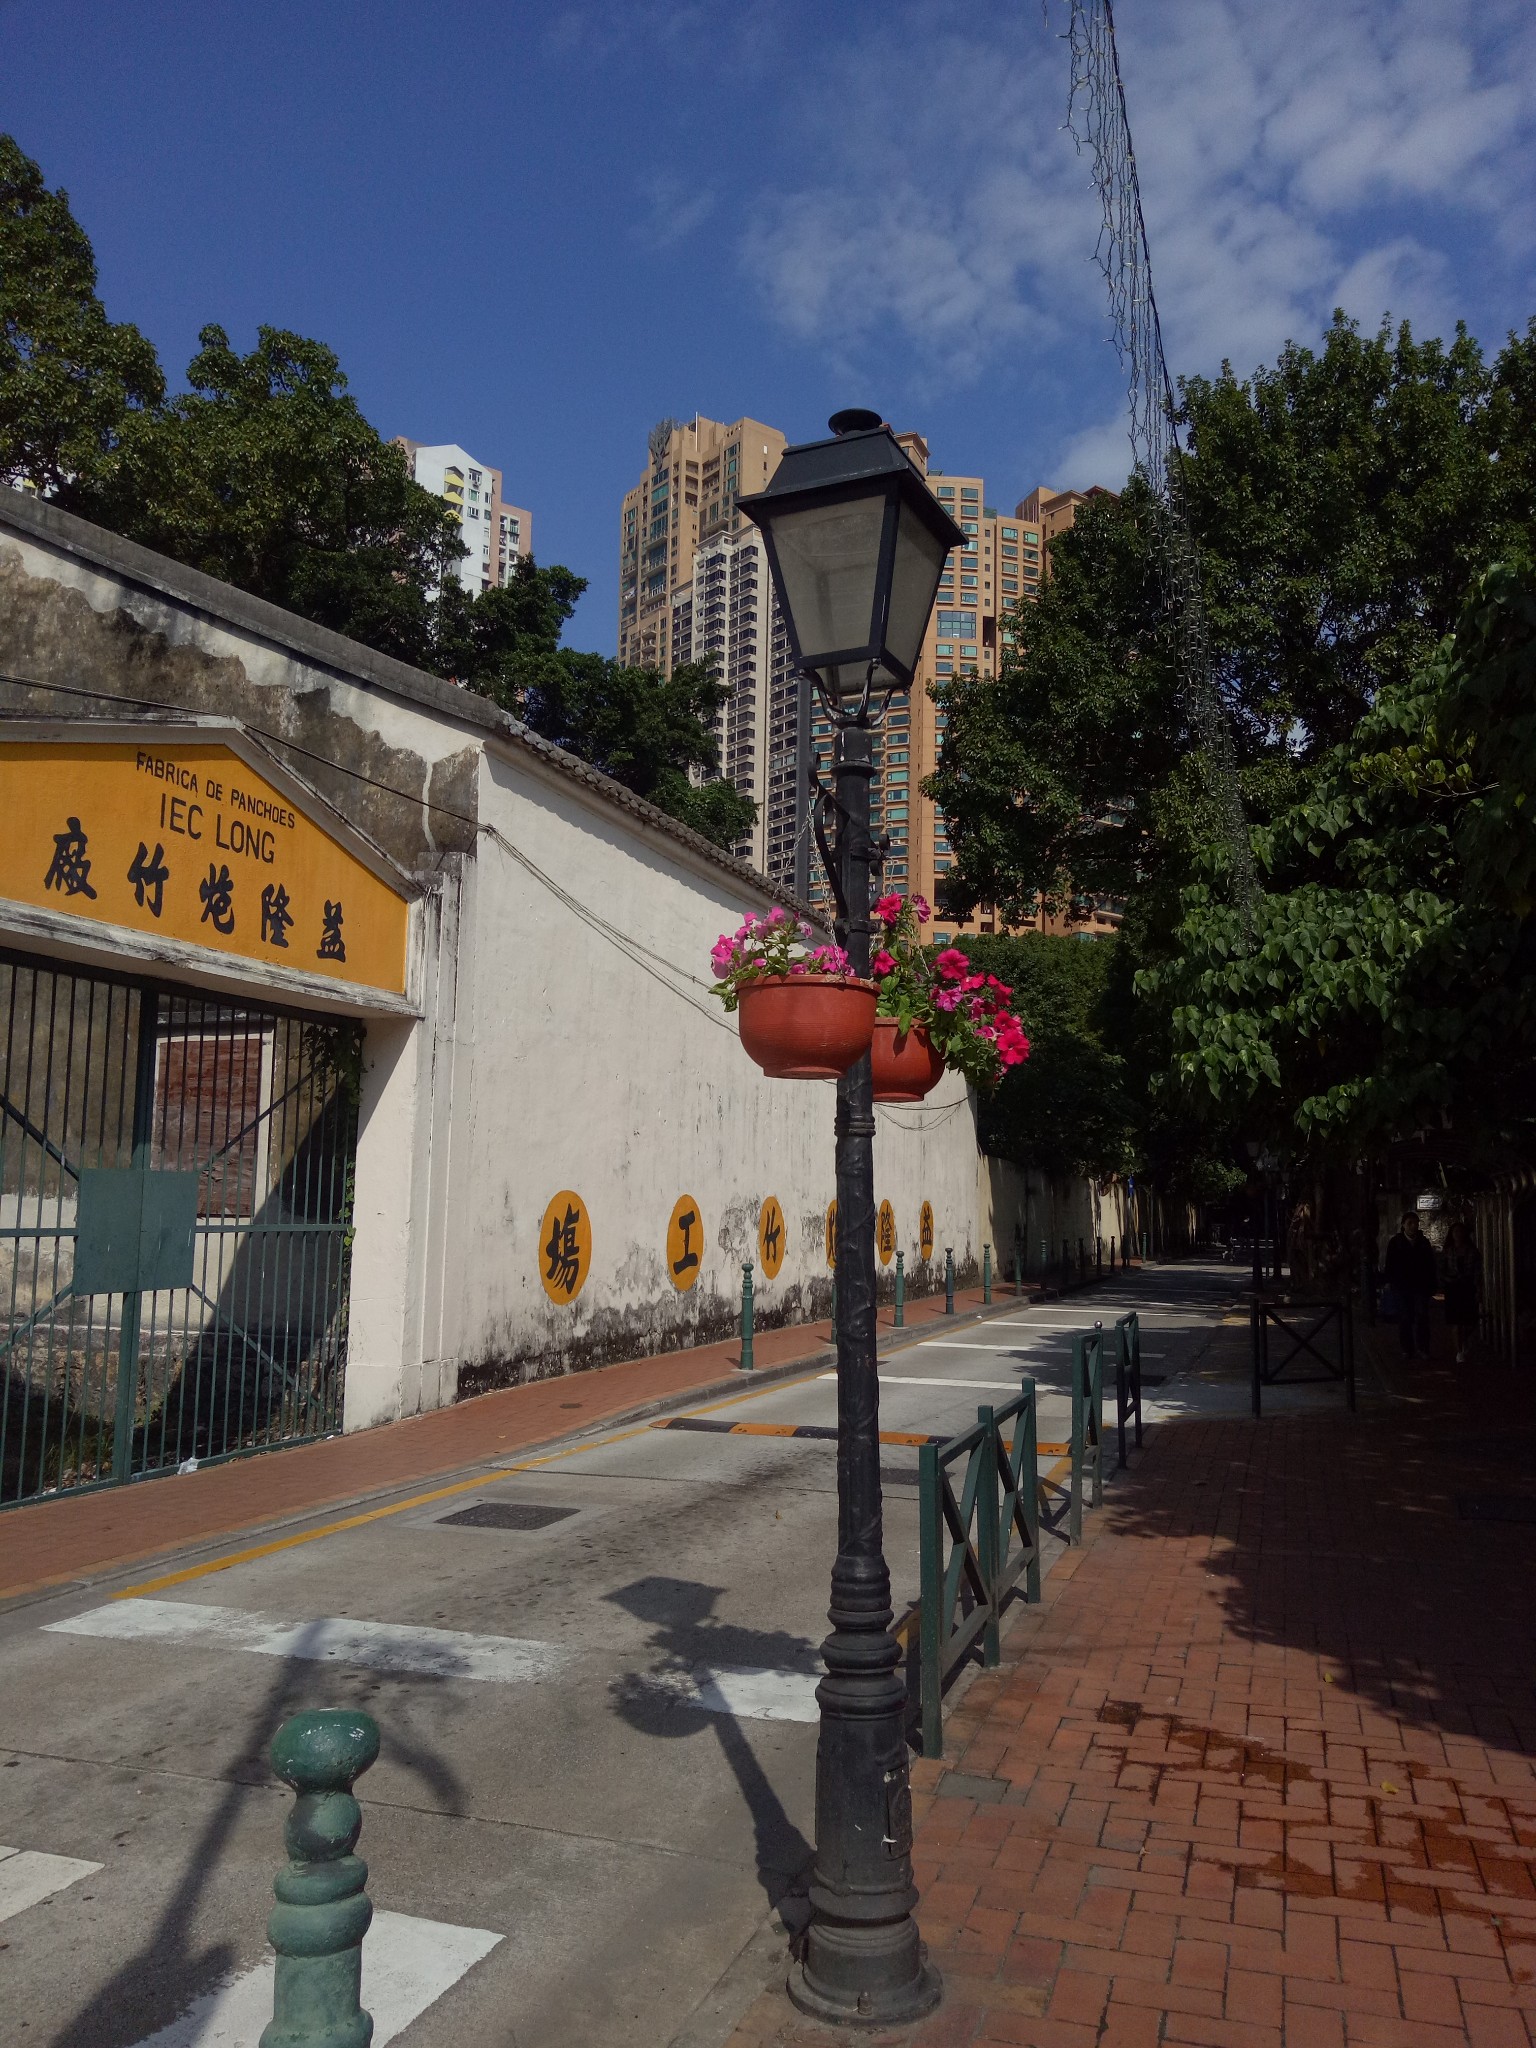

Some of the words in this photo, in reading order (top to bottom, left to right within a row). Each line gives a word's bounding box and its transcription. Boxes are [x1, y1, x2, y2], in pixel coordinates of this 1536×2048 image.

[136, 751, 199, 793] FABRICA
[205, 779, 223, 801] DE
[230, 788, 296, 830] PANCHOES
[160, 792, 203, 841] IEC
[215, 814, 276, 864] LONG
